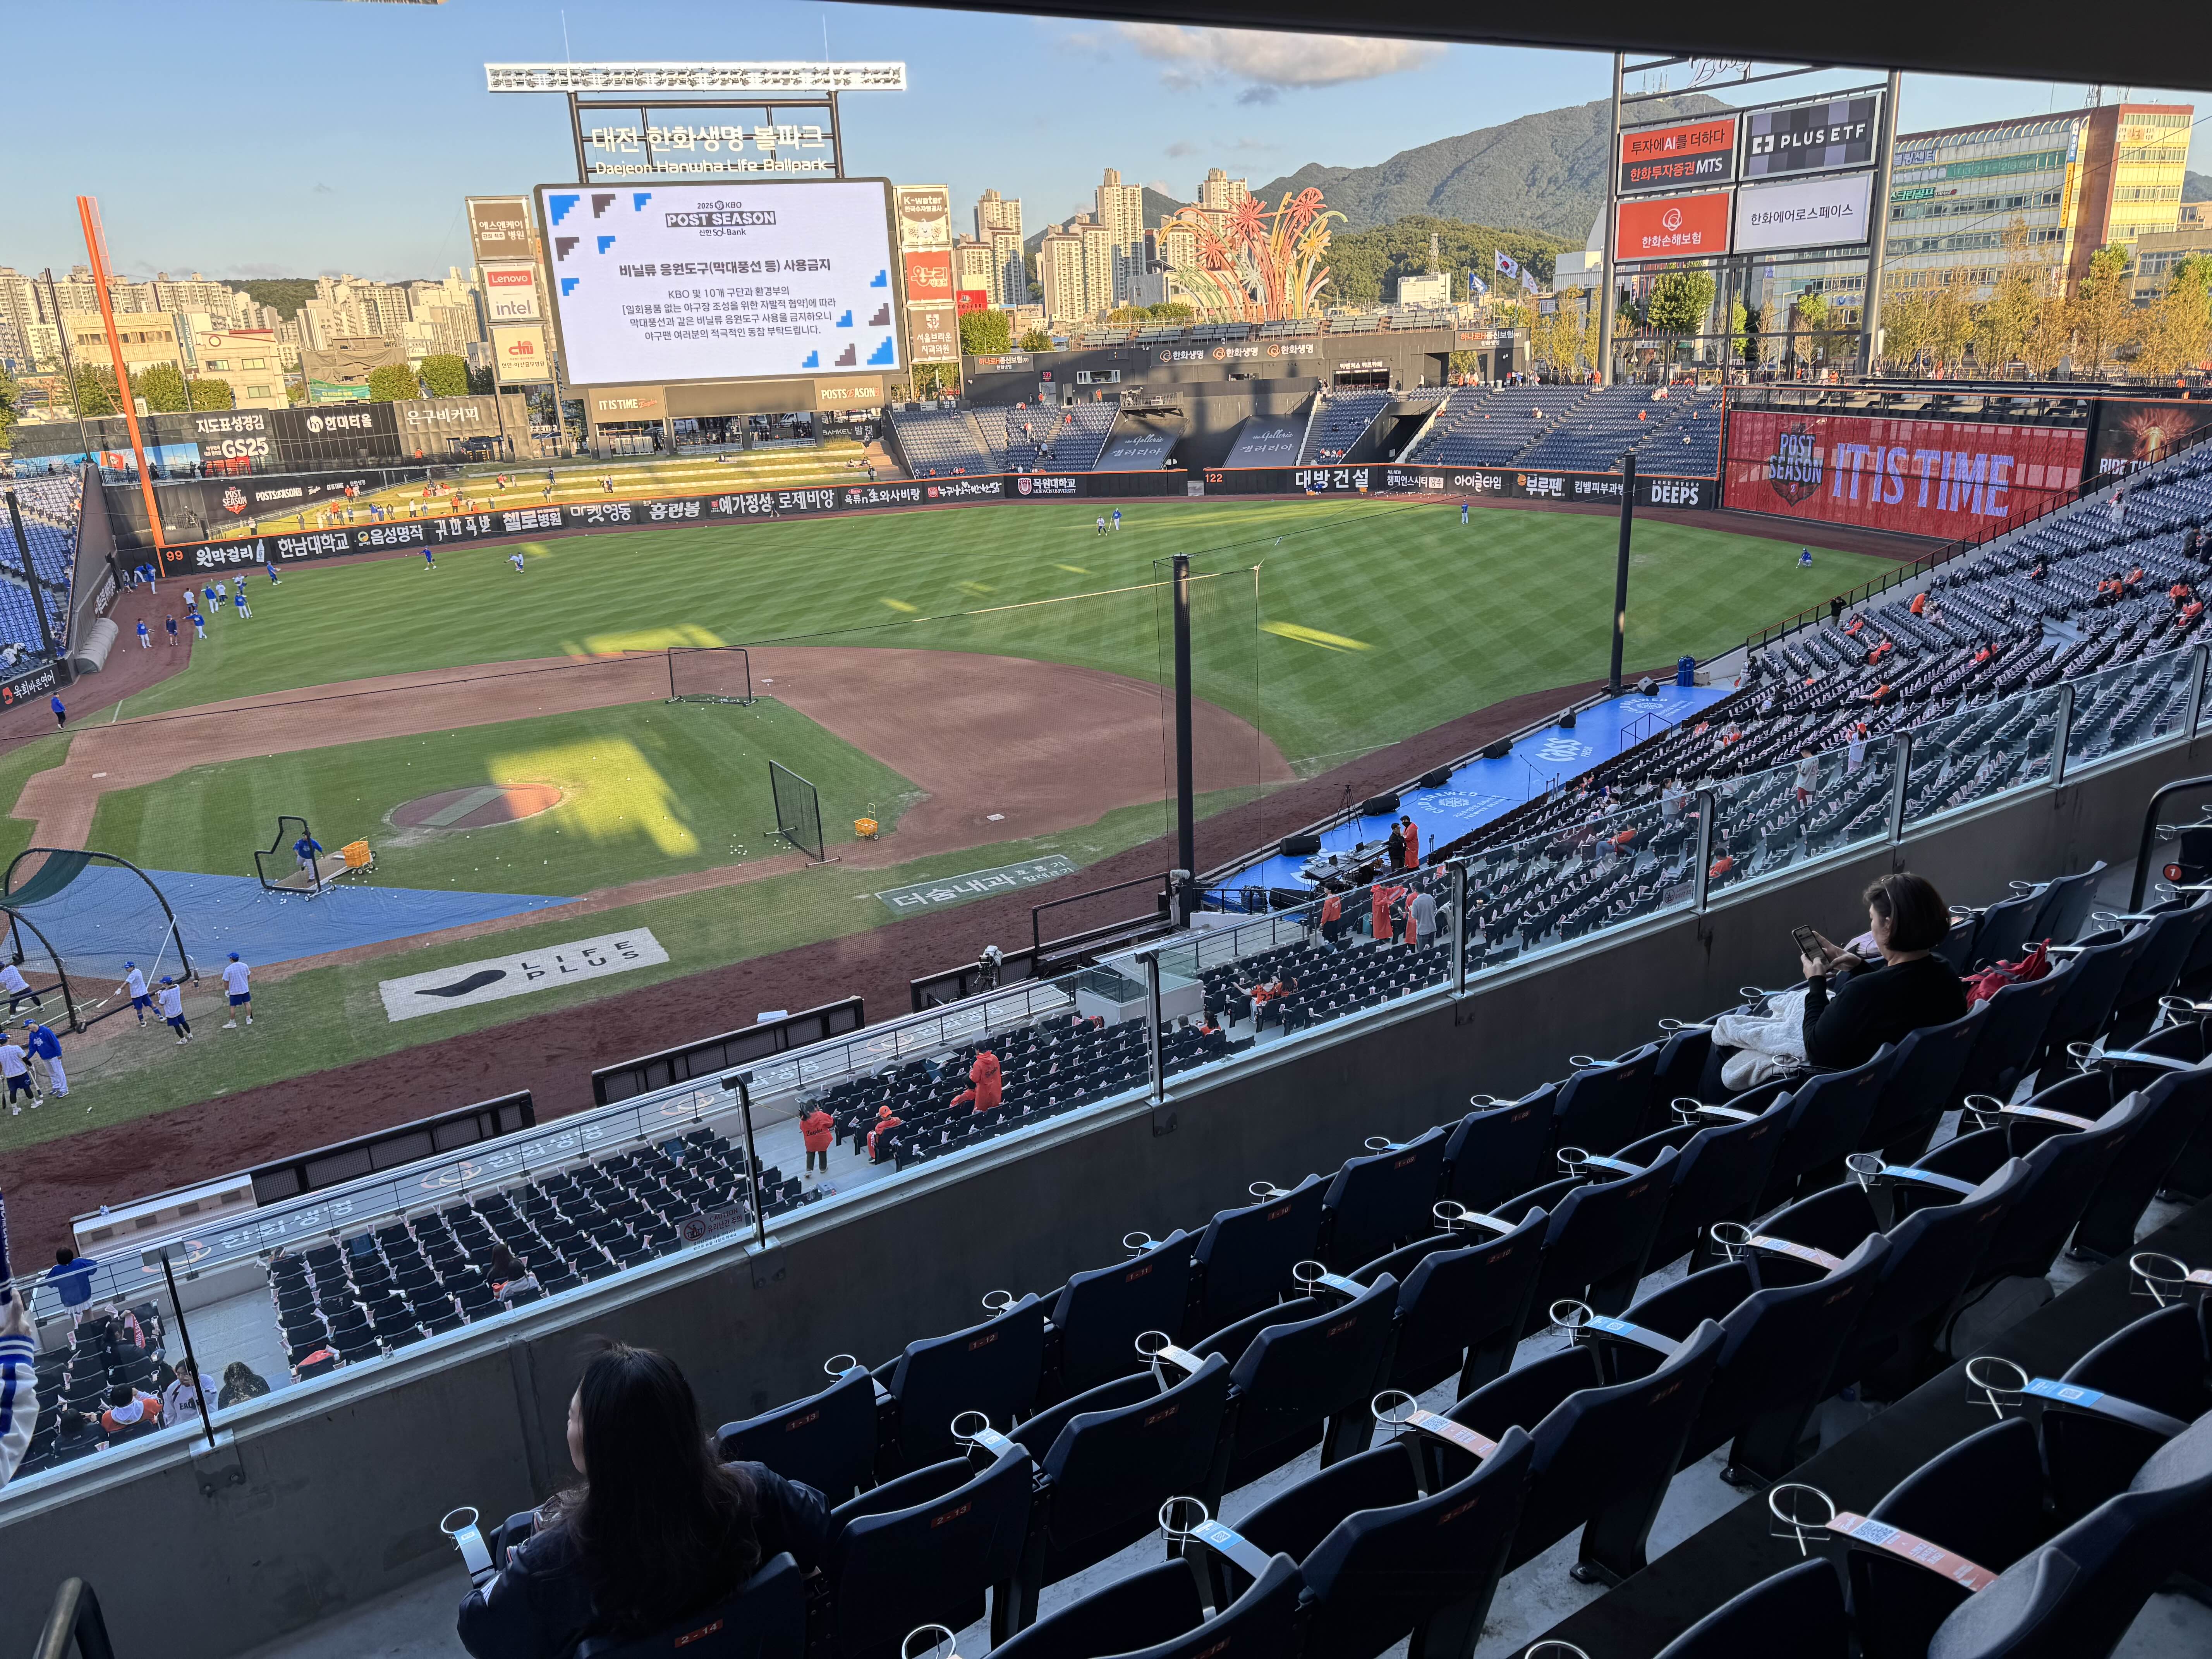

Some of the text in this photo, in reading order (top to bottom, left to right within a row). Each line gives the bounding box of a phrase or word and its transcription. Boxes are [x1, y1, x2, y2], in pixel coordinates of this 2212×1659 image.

[591, 125, 825, 153] 대전 한화생명 볼파크
[1631, 128, 1725, 155] 투자에AI를 더하다
[1781, 123, 1866, 149] PLUS ETF
[596, 158, 827, 177] Daejeon Hanwha Life Ballpark
[1630, 157, 1723, 182] 한화투자증권 MTS
[904, 196, 942, 205] K-water
[667, 211, 775, 227] POST SEASON
[1750, 203, 1853, 226] 한화에어로스페이스
[479, 220, 523, 231] 에스앤케이
[508, 230, 525, 240] 병원
[1642, 232, 1701, 249] 한화손해보험
[620, 259, 830, 278] 비닐류 응원도구(막대풍선 등) 사용금지
[492, 274, 528, 284] Lenovo
[668, 286, 789, 299] KBO 및 10개 구단과 환경부의
[496, 299, 531, 315] intel
[622, 298, 836, 315] [일회용품 없는 야구장 조성을 위한 자발적 협약]에 따라
[630, 312, 832, 328] 막대풍선과 같은 비닐류 응원도구 사용을 금지하오니
[644, 326, 821, 341] 야구팬 여러분의 적극적인 동참 부탁드립니다.
[917, 333, 951, 343] 서울브라운
[922, 344, 949, 355] 치과의원
[1173, 350, 1204, 360] 한화생명
[1226, 347, 1258, 357] 한화생명
[1281, 344, 1314, 354] 한화생명
[617, 399, 638, 409] TIME
[196, 415, 264, 433] 지도표성경김
[325, 414, 372, 430] 한미타올
[406, 406, 479, 425] 은구비커피
[222, 437, 269, 459] GS25
[1110, 448, 1162, 457] 갤러리아
[1240, 443, 1294, 453] 갤러리아
[1780, 434, 1815, 457] POST
[2100, 458, 2126, 476] RIDE
[1032, 478, 1076, 488] 목원대학교
[1205, 474, 1223, 483] 122
[1295, 468, 1369, 488] 대방건설
[1387, 475, 1428, 488] 챔피언스시티
[1454, 472, 1502, 493] 아이클타임
[1526, 476, 1562, 496] 부루펜
[1832, 443, 2014, 518] IT IS TIME
[222, 496, 247, 507] SEASON
[225, 489, 242, 498] POST
[719, 493, 773, 515] 예가정성
[778, 489, 835, 510] 로제비앙
[1651, 485, 1699, 505] DEEPS
[570, 502, 632, 523] 마켓영동
[649, 501, 701, 520] 홈런볼
[370, 525, 424, 546] 음성명작
[277, 533, 349, 558] 한남대학교
[166, 551, 184, 562] 99
[196, 546, 253, 567] 원막걸리
[14, 669, 56, 699] 육회바른연어
[892, 873, 1017, 907] 더숨내과
[521, 941, 633, 970] LIFE
[526, 950, 639, 981] PLUS
[914, 1005, 1004, 1036] 한화생명
[485, 1125, 605, 1170] 한화생명
[220, 1199, 354, 1249] 한화생명
[708, 1214, 743, 1233] 유리난간 주의
[710, 1208, 738, 1222] CAUTION
